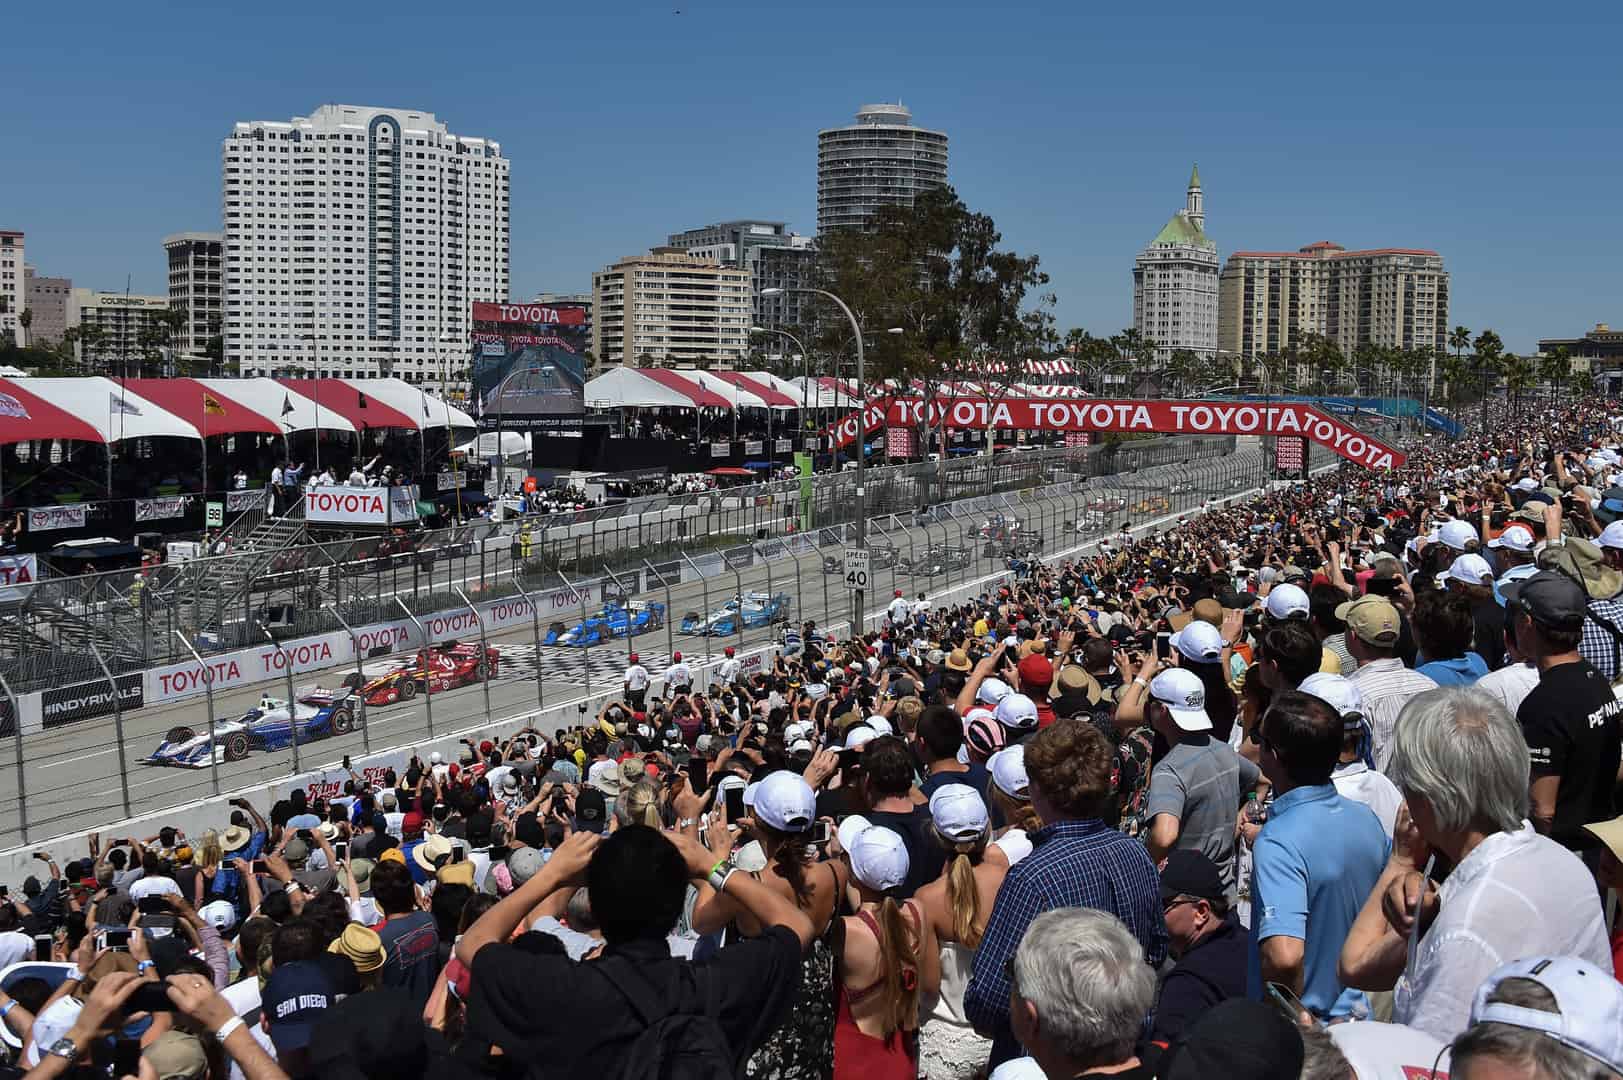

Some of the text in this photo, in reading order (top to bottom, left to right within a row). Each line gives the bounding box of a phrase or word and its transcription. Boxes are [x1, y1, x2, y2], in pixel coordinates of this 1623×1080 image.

[500, 305, 559, 323] TOYOTA
[895, 400, 1014, 426] TOYOTA
[1029, 403, 1153, 429] TOYOTA
[1170, 406, 1301, 433] TOYOTA
[1302, 412, 1394, 472] TOYOTA
[307, 493, 385, 513] TOYOTA
[846, 551, 868, 560] SPEED
[847, 571, 867, 586] 40
[550, 588, 592, 608] TOYOTA
[491, 600, 536, 623] TOYOTA
[424, 612, 480, 637] TOYOTA
[351, 626, 409, 653] TOYOTA
[262, 642, 332, 672] TOYOTA
[159, 660, 241, 695] TOYOTA
[276, 997, 297, 1018] SAN
[299, 994, 327, 1009] DIEGO
